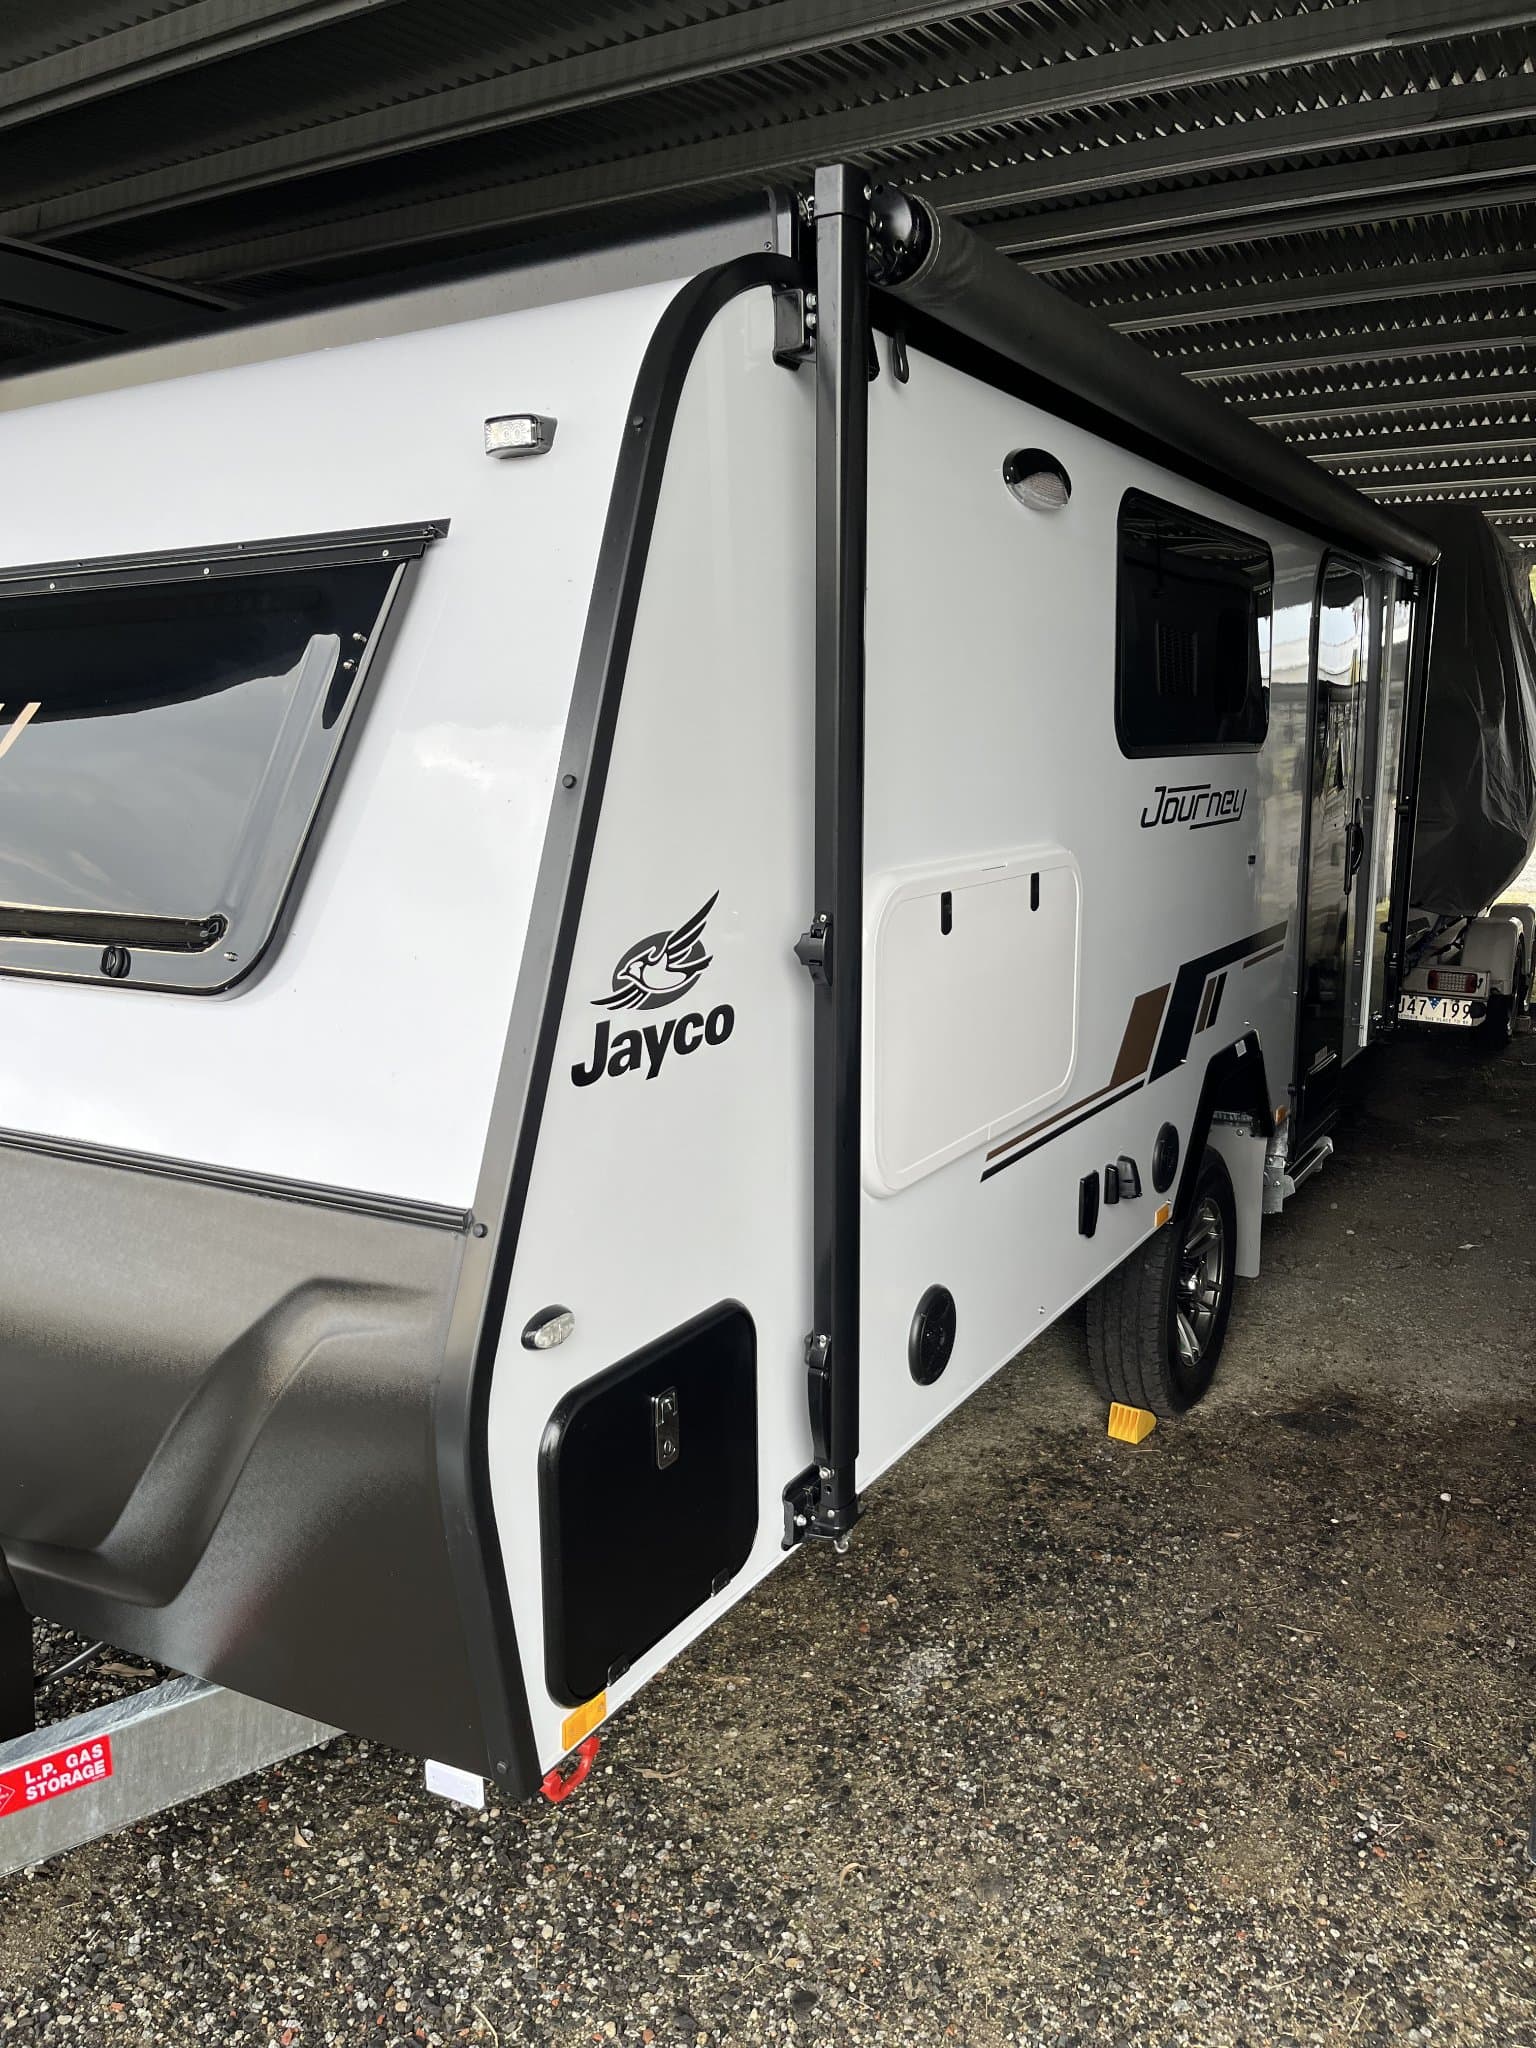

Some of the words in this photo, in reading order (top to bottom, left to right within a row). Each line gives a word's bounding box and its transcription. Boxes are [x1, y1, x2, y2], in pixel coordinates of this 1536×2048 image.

[1141, 784, 1247, 829] Journey
[1442, 1002, 1471, 1019] 199
[571, 1004, 735, 1087] Jayco
[25, 1763, 57, 1785] L.P.
[66, 1744, 103, 1768] GAS
[26, 1760, 105, 1800] STORAGE
